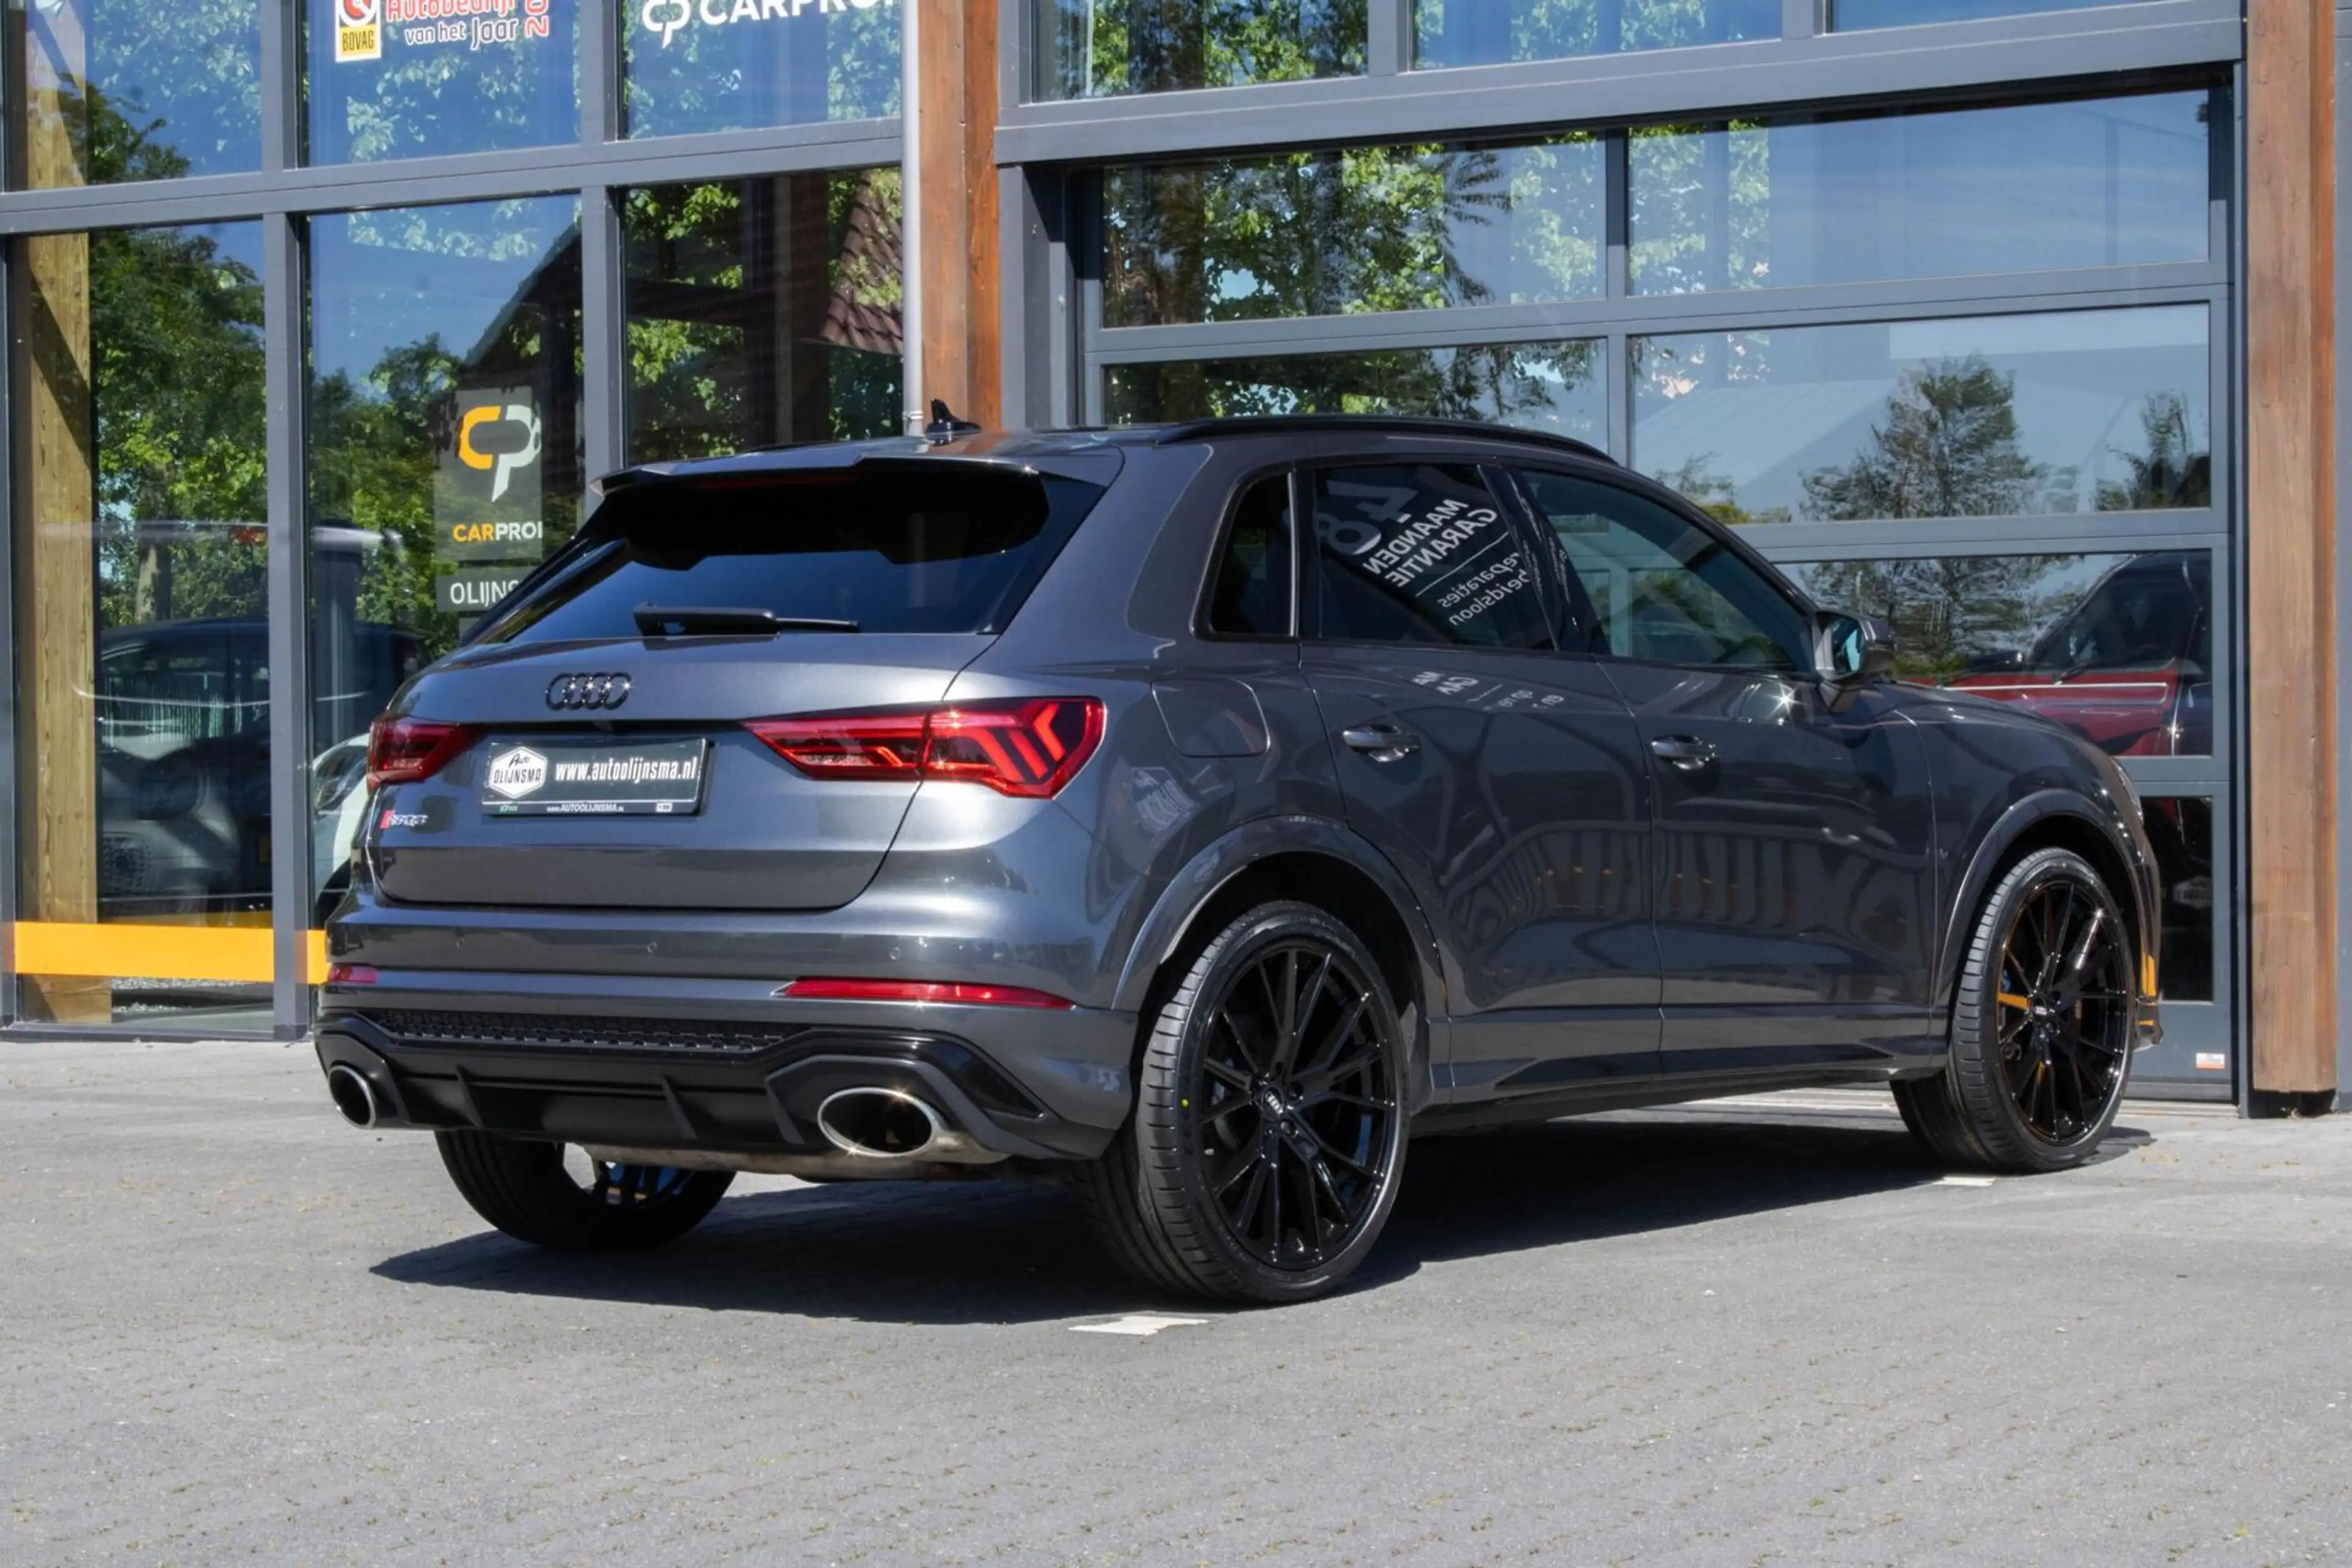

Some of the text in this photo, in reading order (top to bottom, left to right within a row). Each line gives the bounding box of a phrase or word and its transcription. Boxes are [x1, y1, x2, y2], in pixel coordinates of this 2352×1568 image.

[342, 29, 374, 51] BOVAG
[405, 28, 435, 45] van
[439, 23, 466, 41] het
[493, 768, 541, 784] OLIJNSMA
[555, 757, 698, 783] www.autoolijnsma.nl
